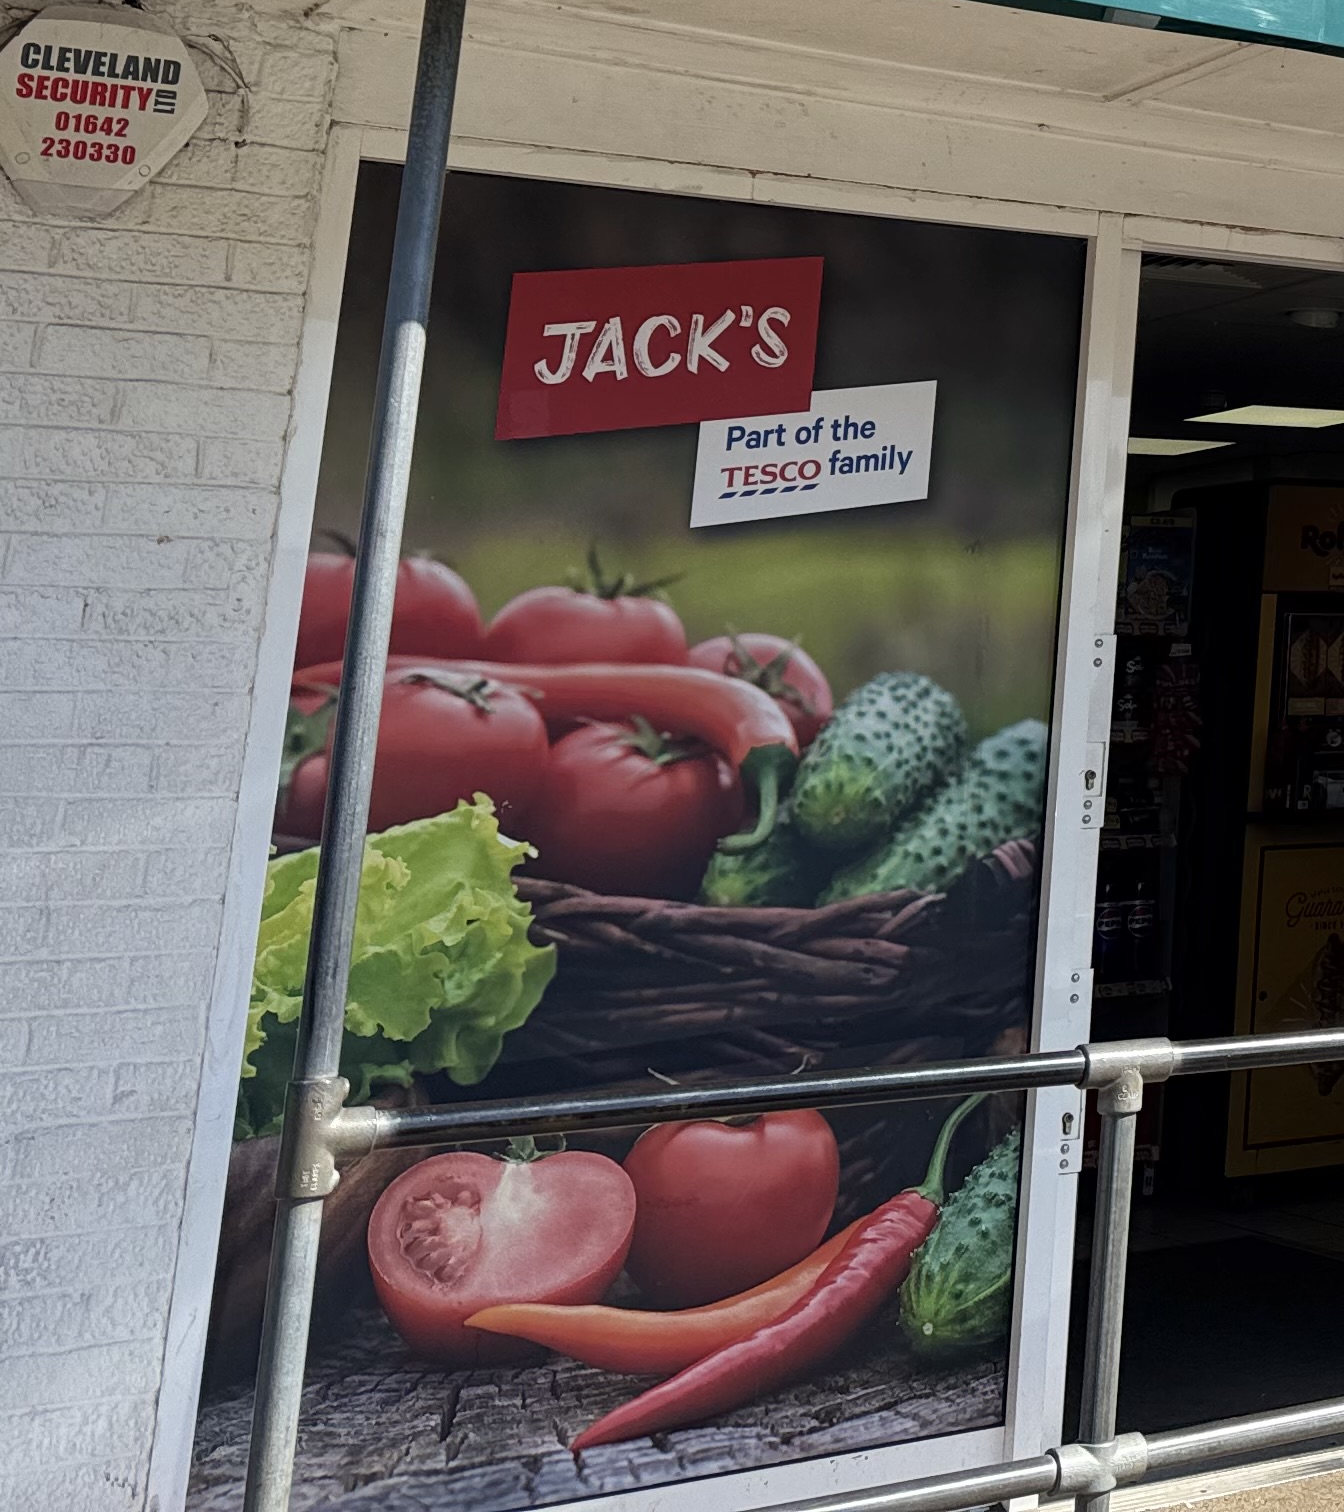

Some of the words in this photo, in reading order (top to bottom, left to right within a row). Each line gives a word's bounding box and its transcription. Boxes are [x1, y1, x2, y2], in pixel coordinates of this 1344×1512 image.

[20, 42, 182, 86] CLEVELAND
[15, 73, 154, 112] SECURITY
[153, 89, 177, 115] LTD
[55, 111, 130, 138] 01642
[40, 137, 136, 165] 230330
[534, 305, 791, 385] JACK'S
[725, 422, 786, 451] Part
[795, 417, 827, 445] of
[831, 415, 876, 442] the
[720, 459, 821, 488] TESCO
[828, 445, 913, 478] family
